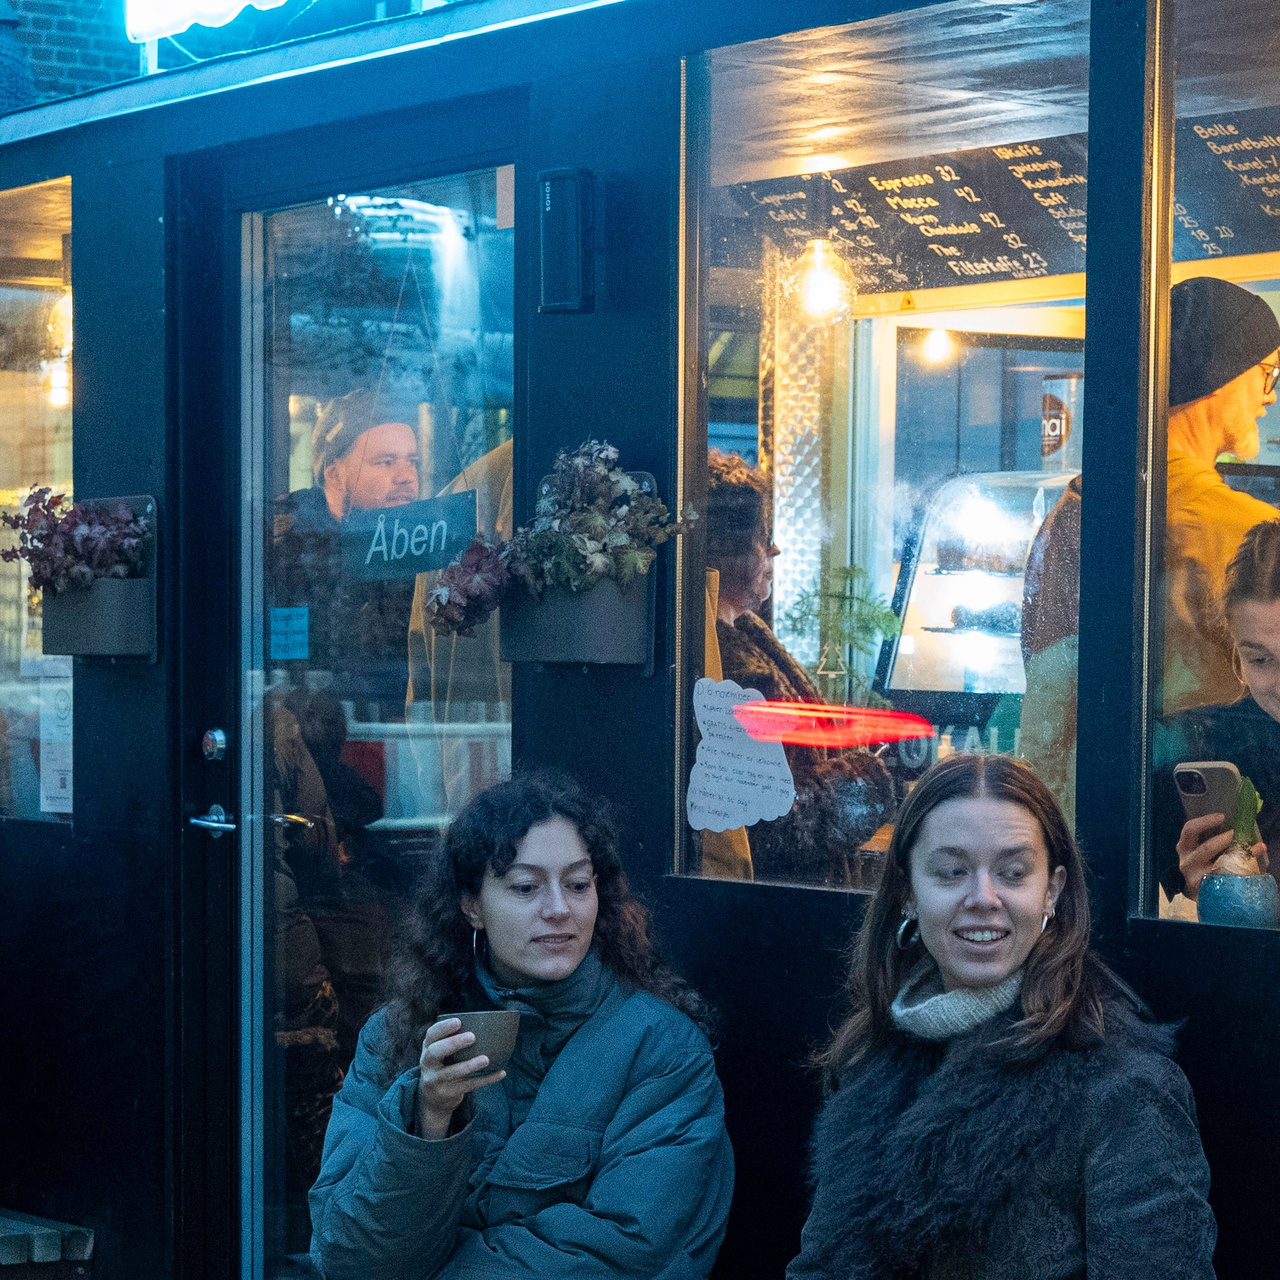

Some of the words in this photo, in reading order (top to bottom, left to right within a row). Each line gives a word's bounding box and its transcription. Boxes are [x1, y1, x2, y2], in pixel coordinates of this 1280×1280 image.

[1193, 123, 1239, 139] Bolle
[868, 173, 935, 194] Espresso
[935, 165, 961, 182] 32
[885, 196, 940, 210] Mocca
[953, 186, 981, 203] 42
[919, 221, 981, 238] Chokolade
[979, 212, 1006, 229] 42
[1178, 216, 1199, 228] 25
[1215, 225, 1234, 238] 20
[1002, 233, 1028, 249] 32
[1203, 243, 1223, 255] 25
[1022, 251, 1048, 269] 23
[364, 513, 448, 565] Åben
